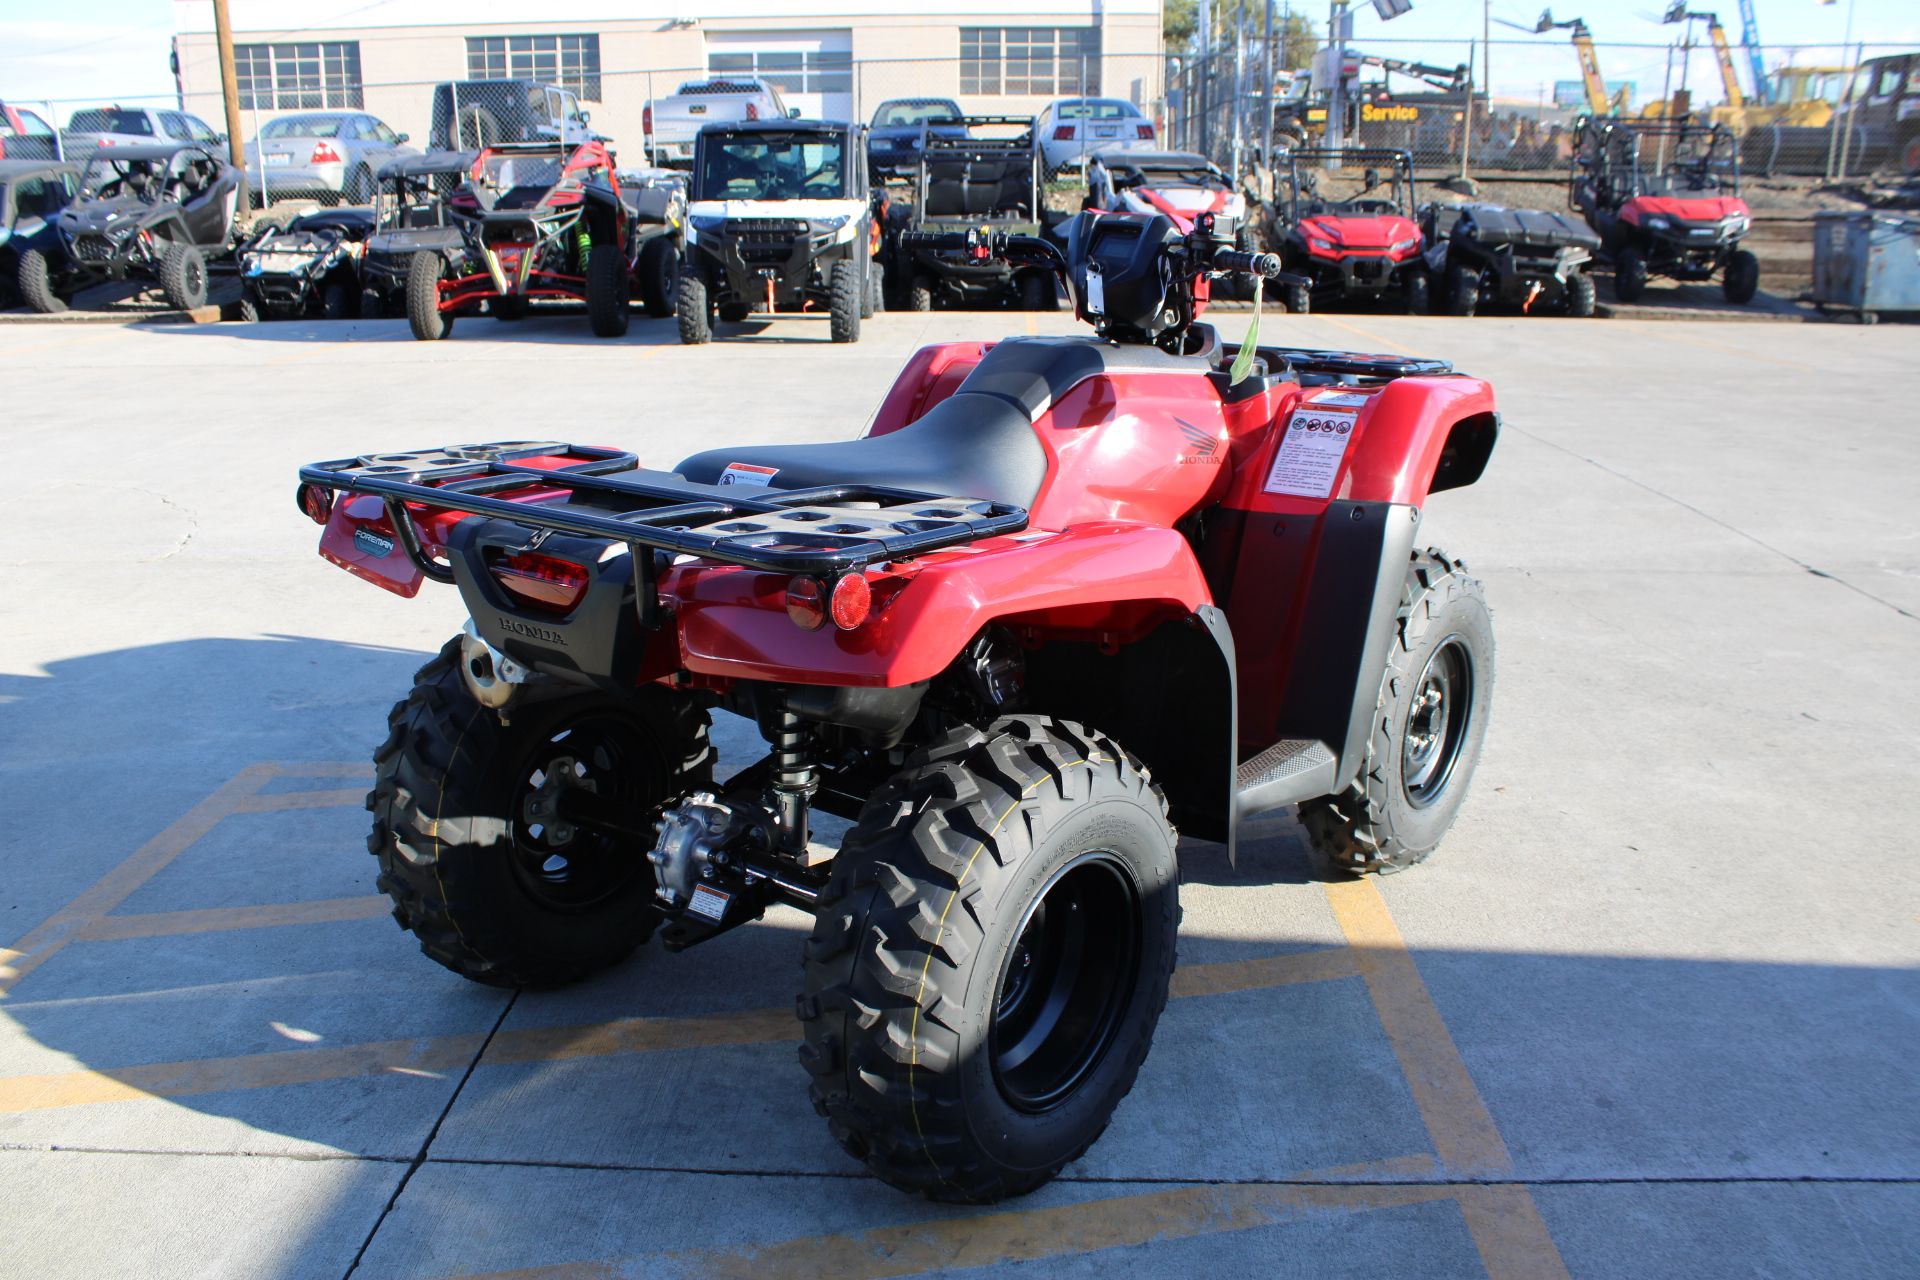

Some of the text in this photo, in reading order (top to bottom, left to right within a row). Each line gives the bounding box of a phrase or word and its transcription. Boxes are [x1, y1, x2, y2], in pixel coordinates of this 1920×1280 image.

[1362, 103, 1419, 122] Service
[1180, 456, 1222, 465] HONDA
[354, 529, 394, 551] FOREMAN
[497, 617, 569, 646] HONDA
